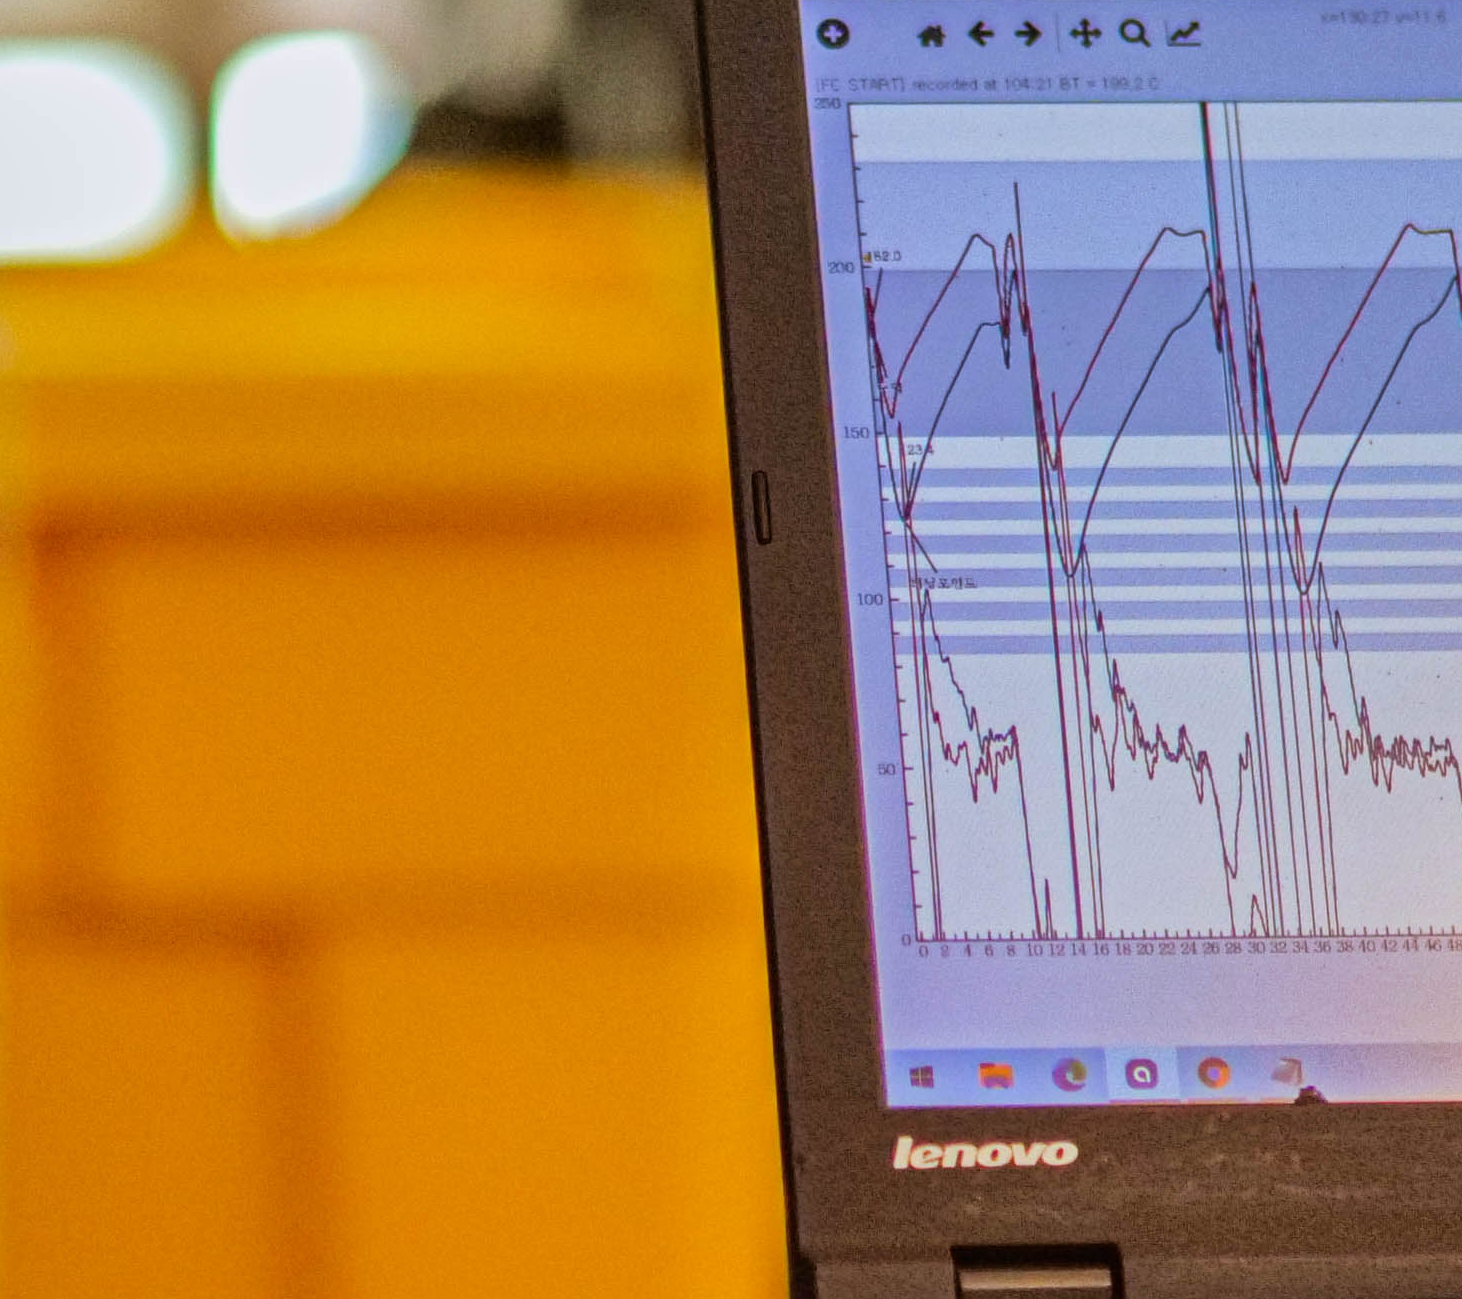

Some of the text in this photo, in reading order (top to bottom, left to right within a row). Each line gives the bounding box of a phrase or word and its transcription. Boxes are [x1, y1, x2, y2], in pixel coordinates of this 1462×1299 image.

[912, 77, 979, 92] recorded
[983, 79, 997, 91] at
[828, 261, 855, 274] 200
[843, 426, 870, 440] 150
[857, 592, 884, 606] 100
[878, 763, 897, 776] 50
[918, 944, 929, 957] 0
[940, 944, 950, 957] 2
[962, 943, 972, 956] 4
[984, 943, 994, 956] 6
[1006, 943, 1016, 956] 8
[1027, 943, 1044, 956] 10
[1049, 942, 1066, 955] 12
[1070, 942, 1086, 955] 14
[1092, 942, 1110, 955] 16
[1116, 941, 1132, 954] 18
[1136, 941, 1154, 954] 20
[1158, 941, 1176, 954] 22
[1180, 941, 1198, 954] 24
[1202, 940, 1220, 953] 26
[1224, 940, 1242, 953] 28
[1248, 940, 1266, 953] 30
[1269, 940, 1288, 953] 32
[1292, 939, 1310, 952] 34
[1314, 939, 1332, 952] 36
[1336, 939, 1354, 952] 38
[1358, 938, 1376, 951] 40
[1380, 938, 1398, 951] 42
[1402, 938, 1420, 951] 44
[1425, 938, 1442, 951] 46
[893, 1136, 1079, 1171] lenovo
